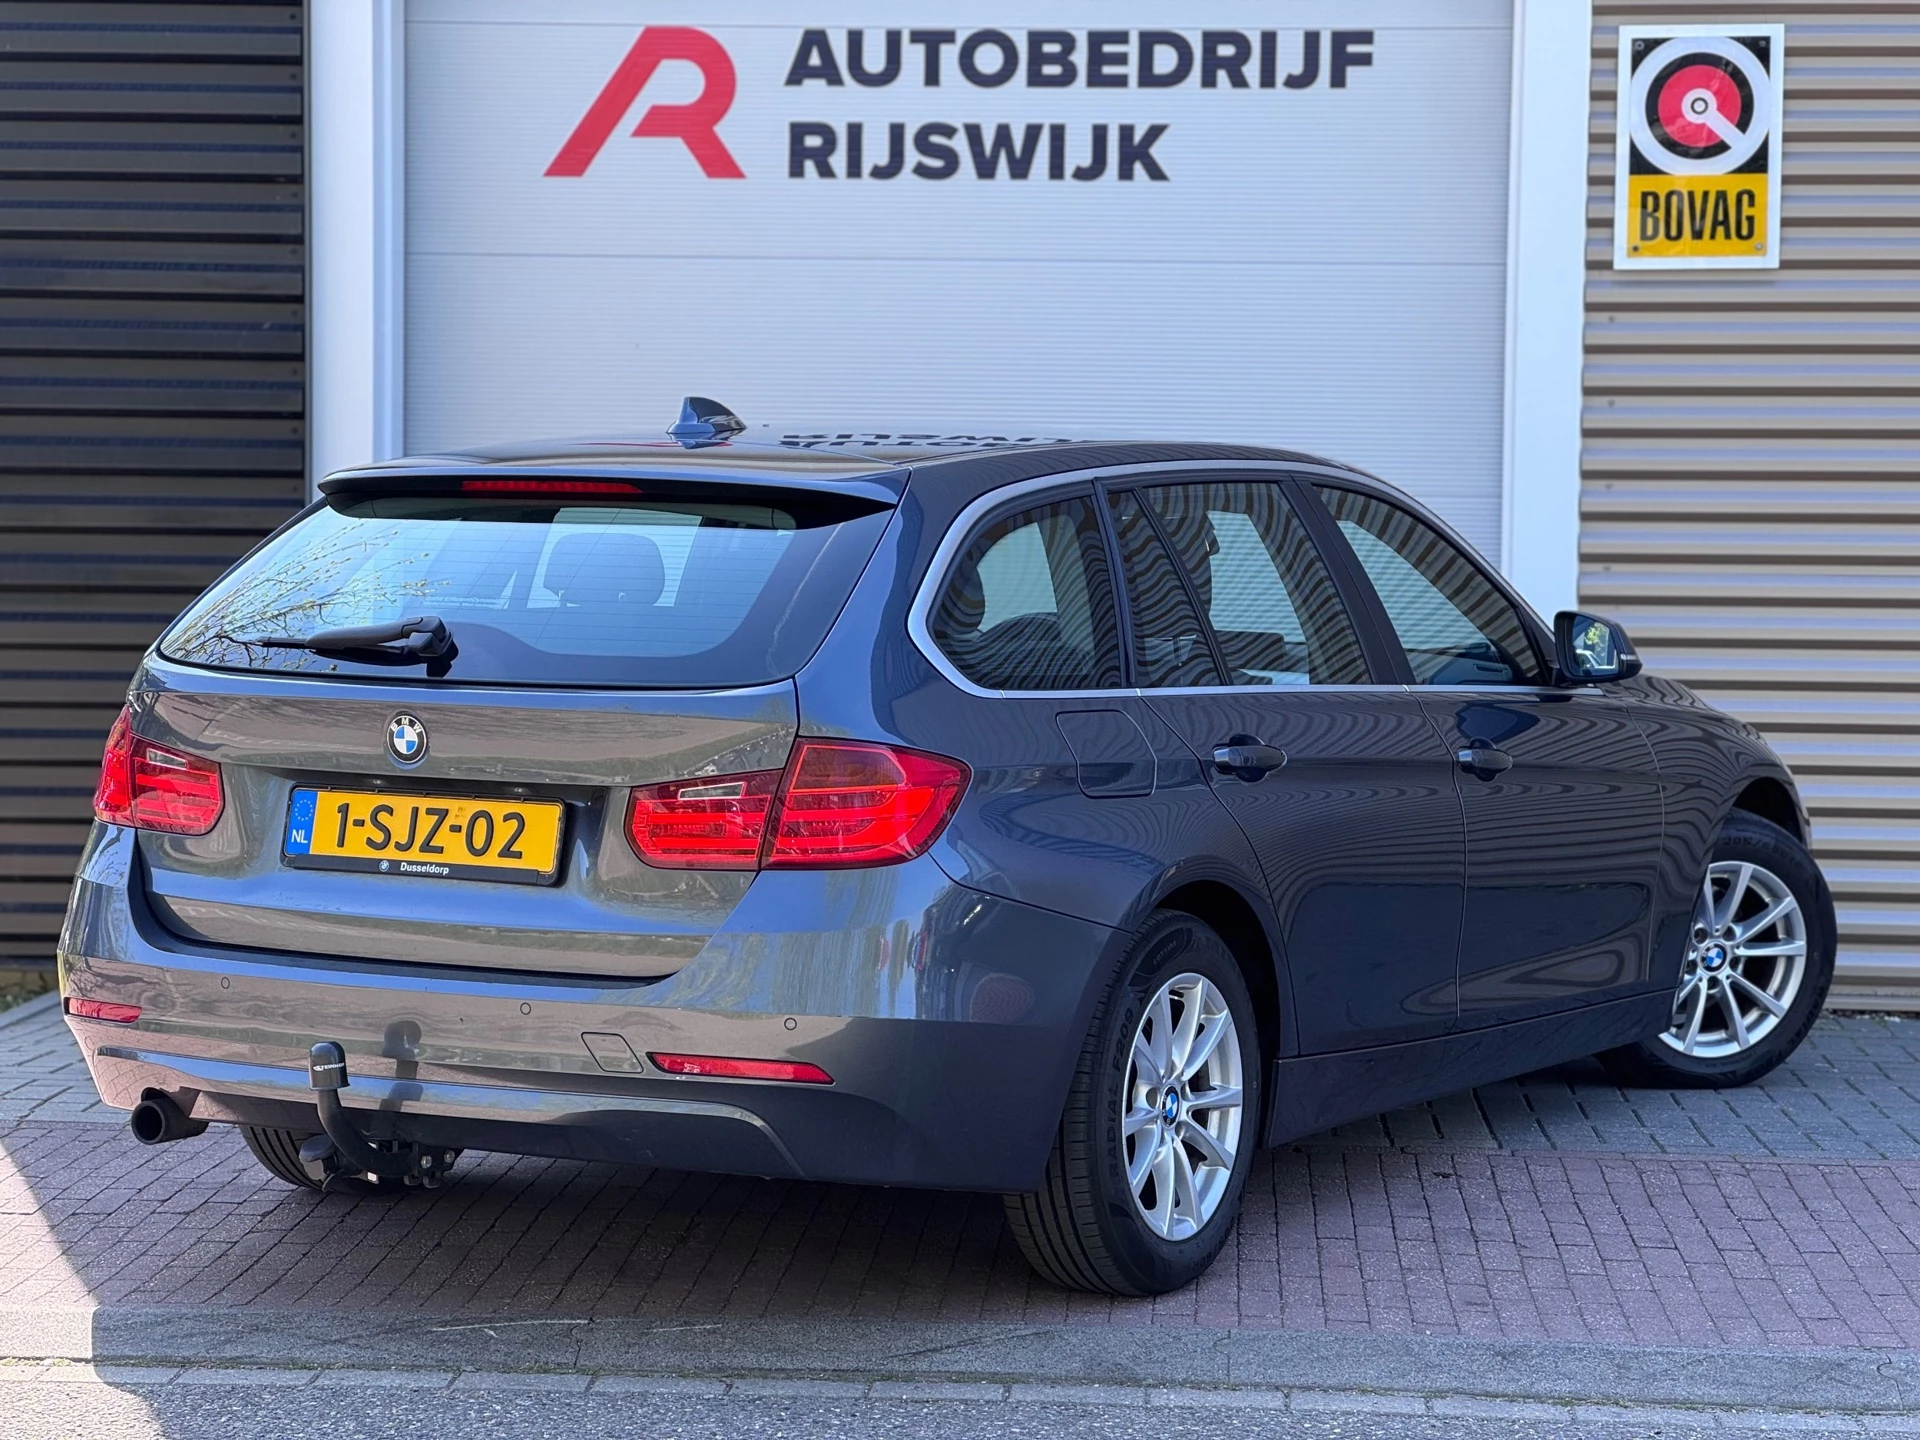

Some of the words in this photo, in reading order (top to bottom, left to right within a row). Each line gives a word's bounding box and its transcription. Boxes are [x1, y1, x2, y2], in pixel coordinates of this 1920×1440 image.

[784, 28, 1375, 90] AUTOBEDRIJF
[788, 121, 1171, 182] RIJSWIJK
[1639, 188, 1756, 242] BOVAG
[390, 716, 422, 734] BMW
[291, 829, 308, 844] NL
[336, 802, 526, 860] 1-SJZ-02
[400, 862, 450, 876] Dusseldorp
